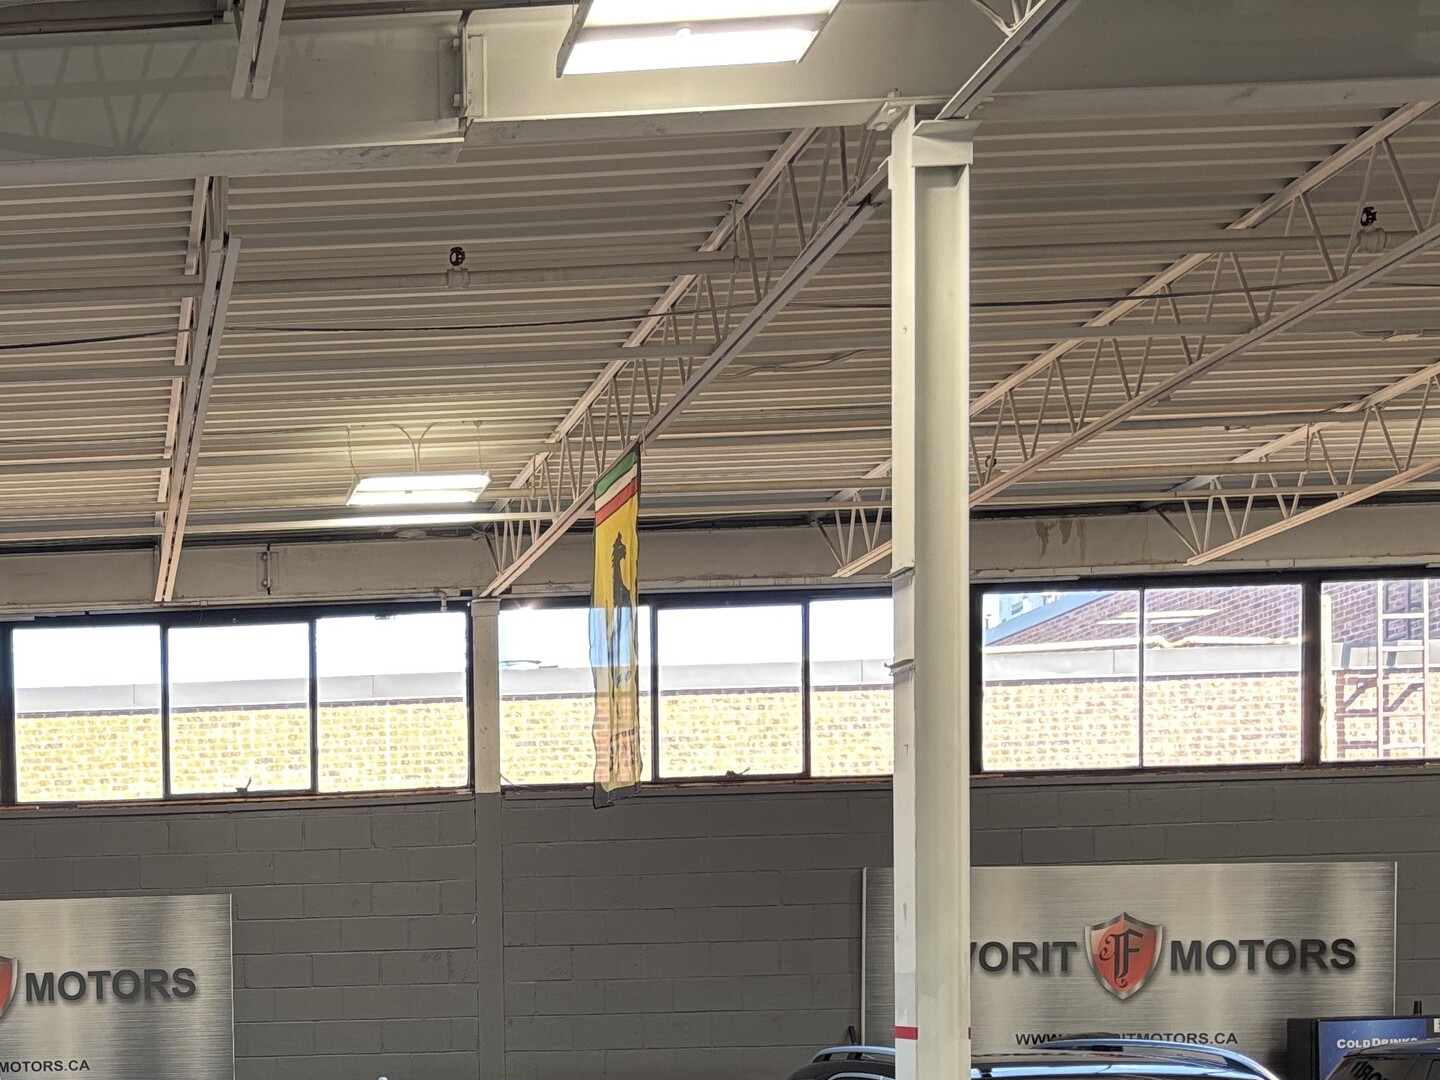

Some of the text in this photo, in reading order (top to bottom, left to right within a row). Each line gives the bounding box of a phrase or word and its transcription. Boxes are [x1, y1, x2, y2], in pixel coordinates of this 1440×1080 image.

[971, 941, 1077, 974] ORIT
[1171, 938, 1356, 975] MOTORS
[25, 967, 196, 1004] MOTORS
